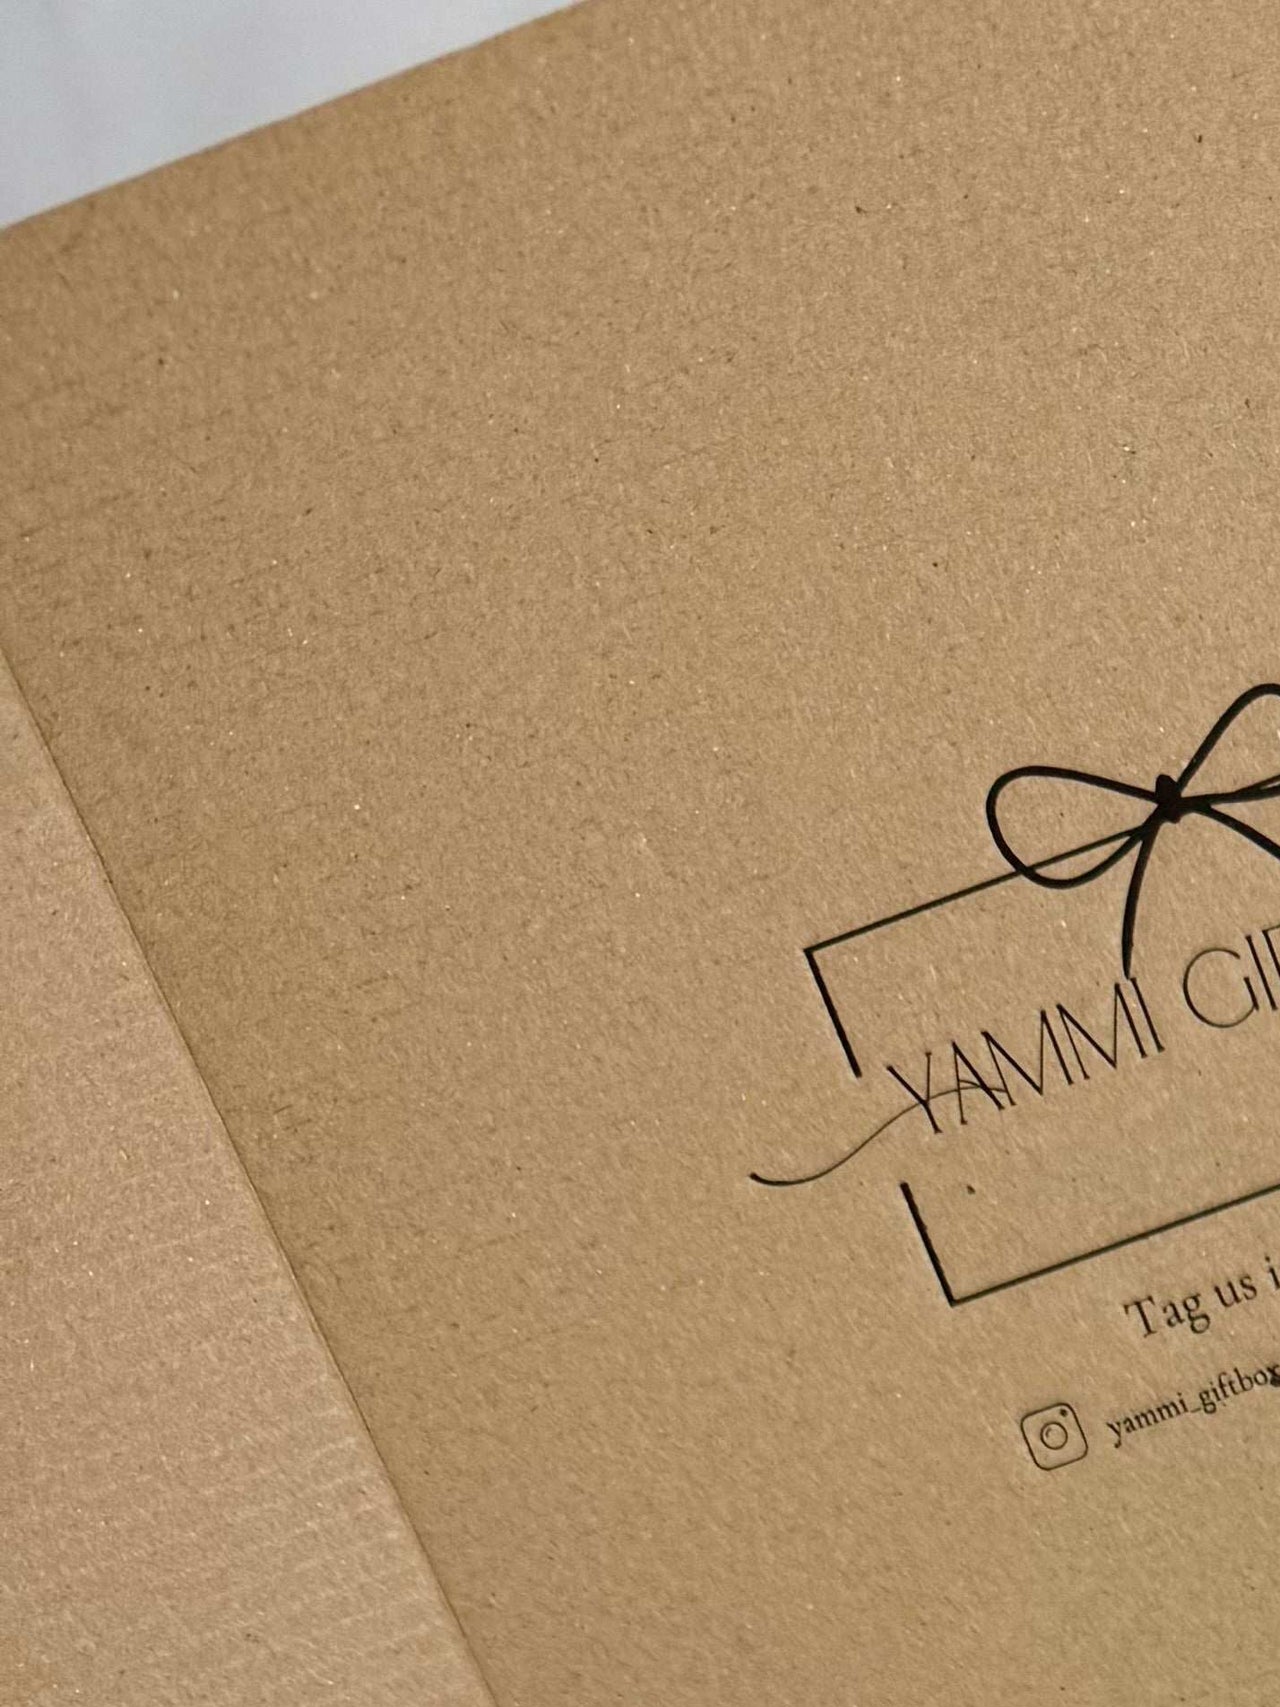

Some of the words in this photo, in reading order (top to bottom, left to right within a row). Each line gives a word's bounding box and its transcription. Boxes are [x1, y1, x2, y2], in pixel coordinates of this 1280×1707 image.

[887, 977, 1165, 1134] YAMMI
[1124, 1295, 1211, 1338] Tag
[1214, 1273, 1258, 1308] us
